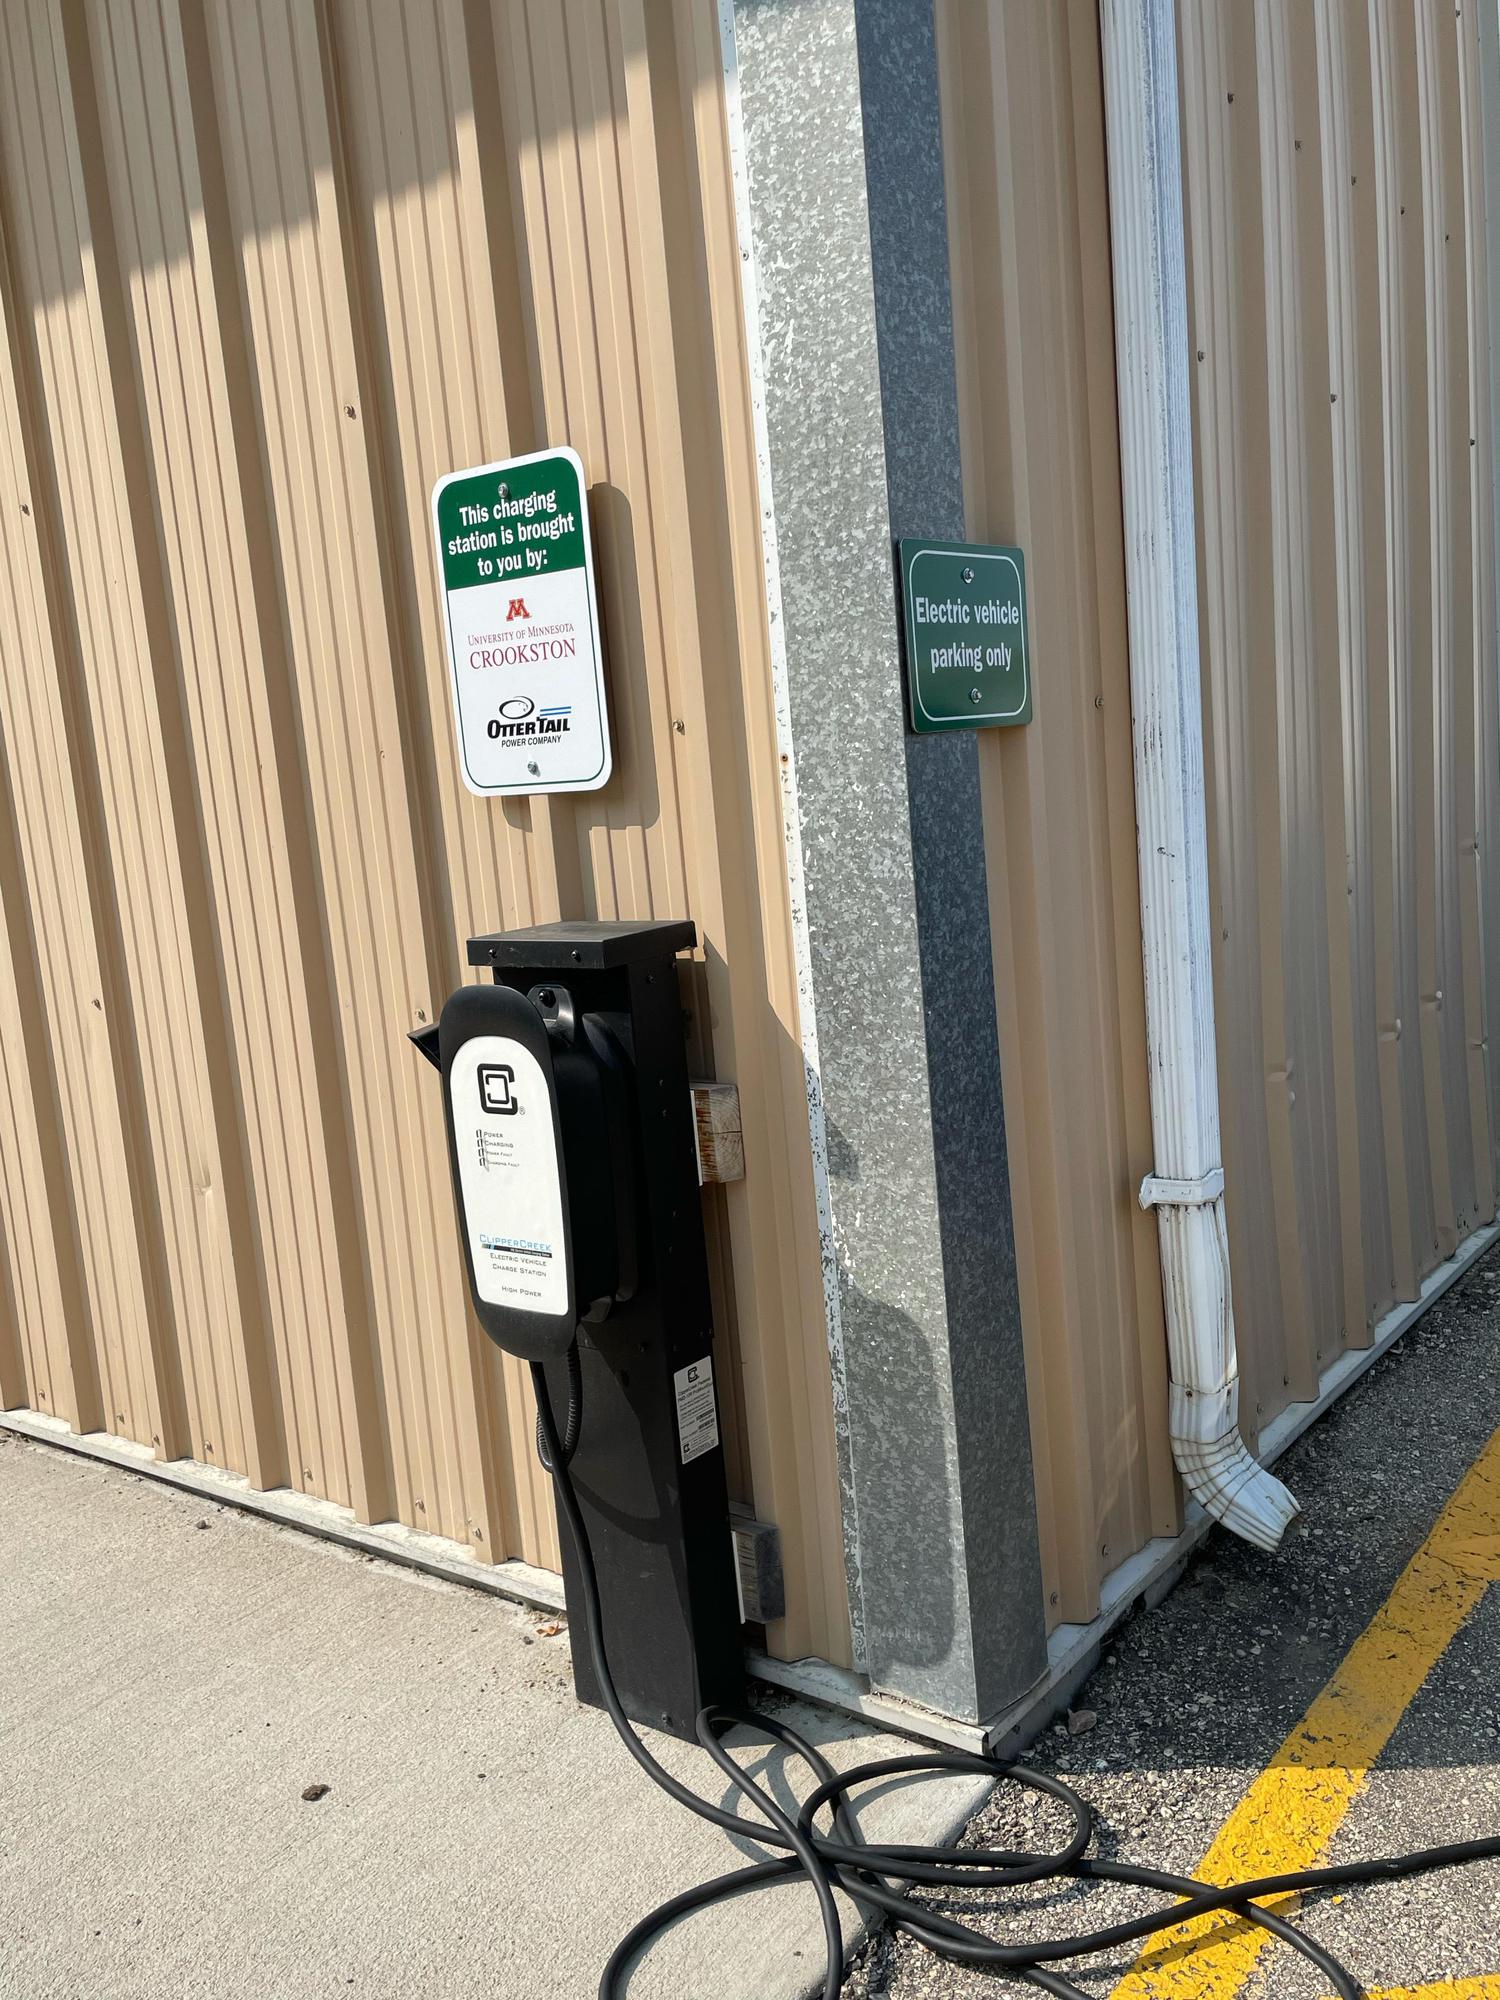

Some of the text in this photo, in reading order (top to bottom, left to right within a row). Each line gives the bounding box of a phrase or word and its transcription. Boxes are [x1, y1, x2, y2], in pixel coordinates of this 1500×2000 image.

[459, 490, 557, 526] This charging
[448, 512, 575, 555] station is brought
[477, 548, 548, 577] to you by:
[506, 598, 532, 622] M
[916, 597, 1019, 624] Electric vehicle
[470, 638, 576, 670] CROOKSTON
[931, 642, 1012, 673] parking only
[501, 735, 562, 748] POWER COMPANY
